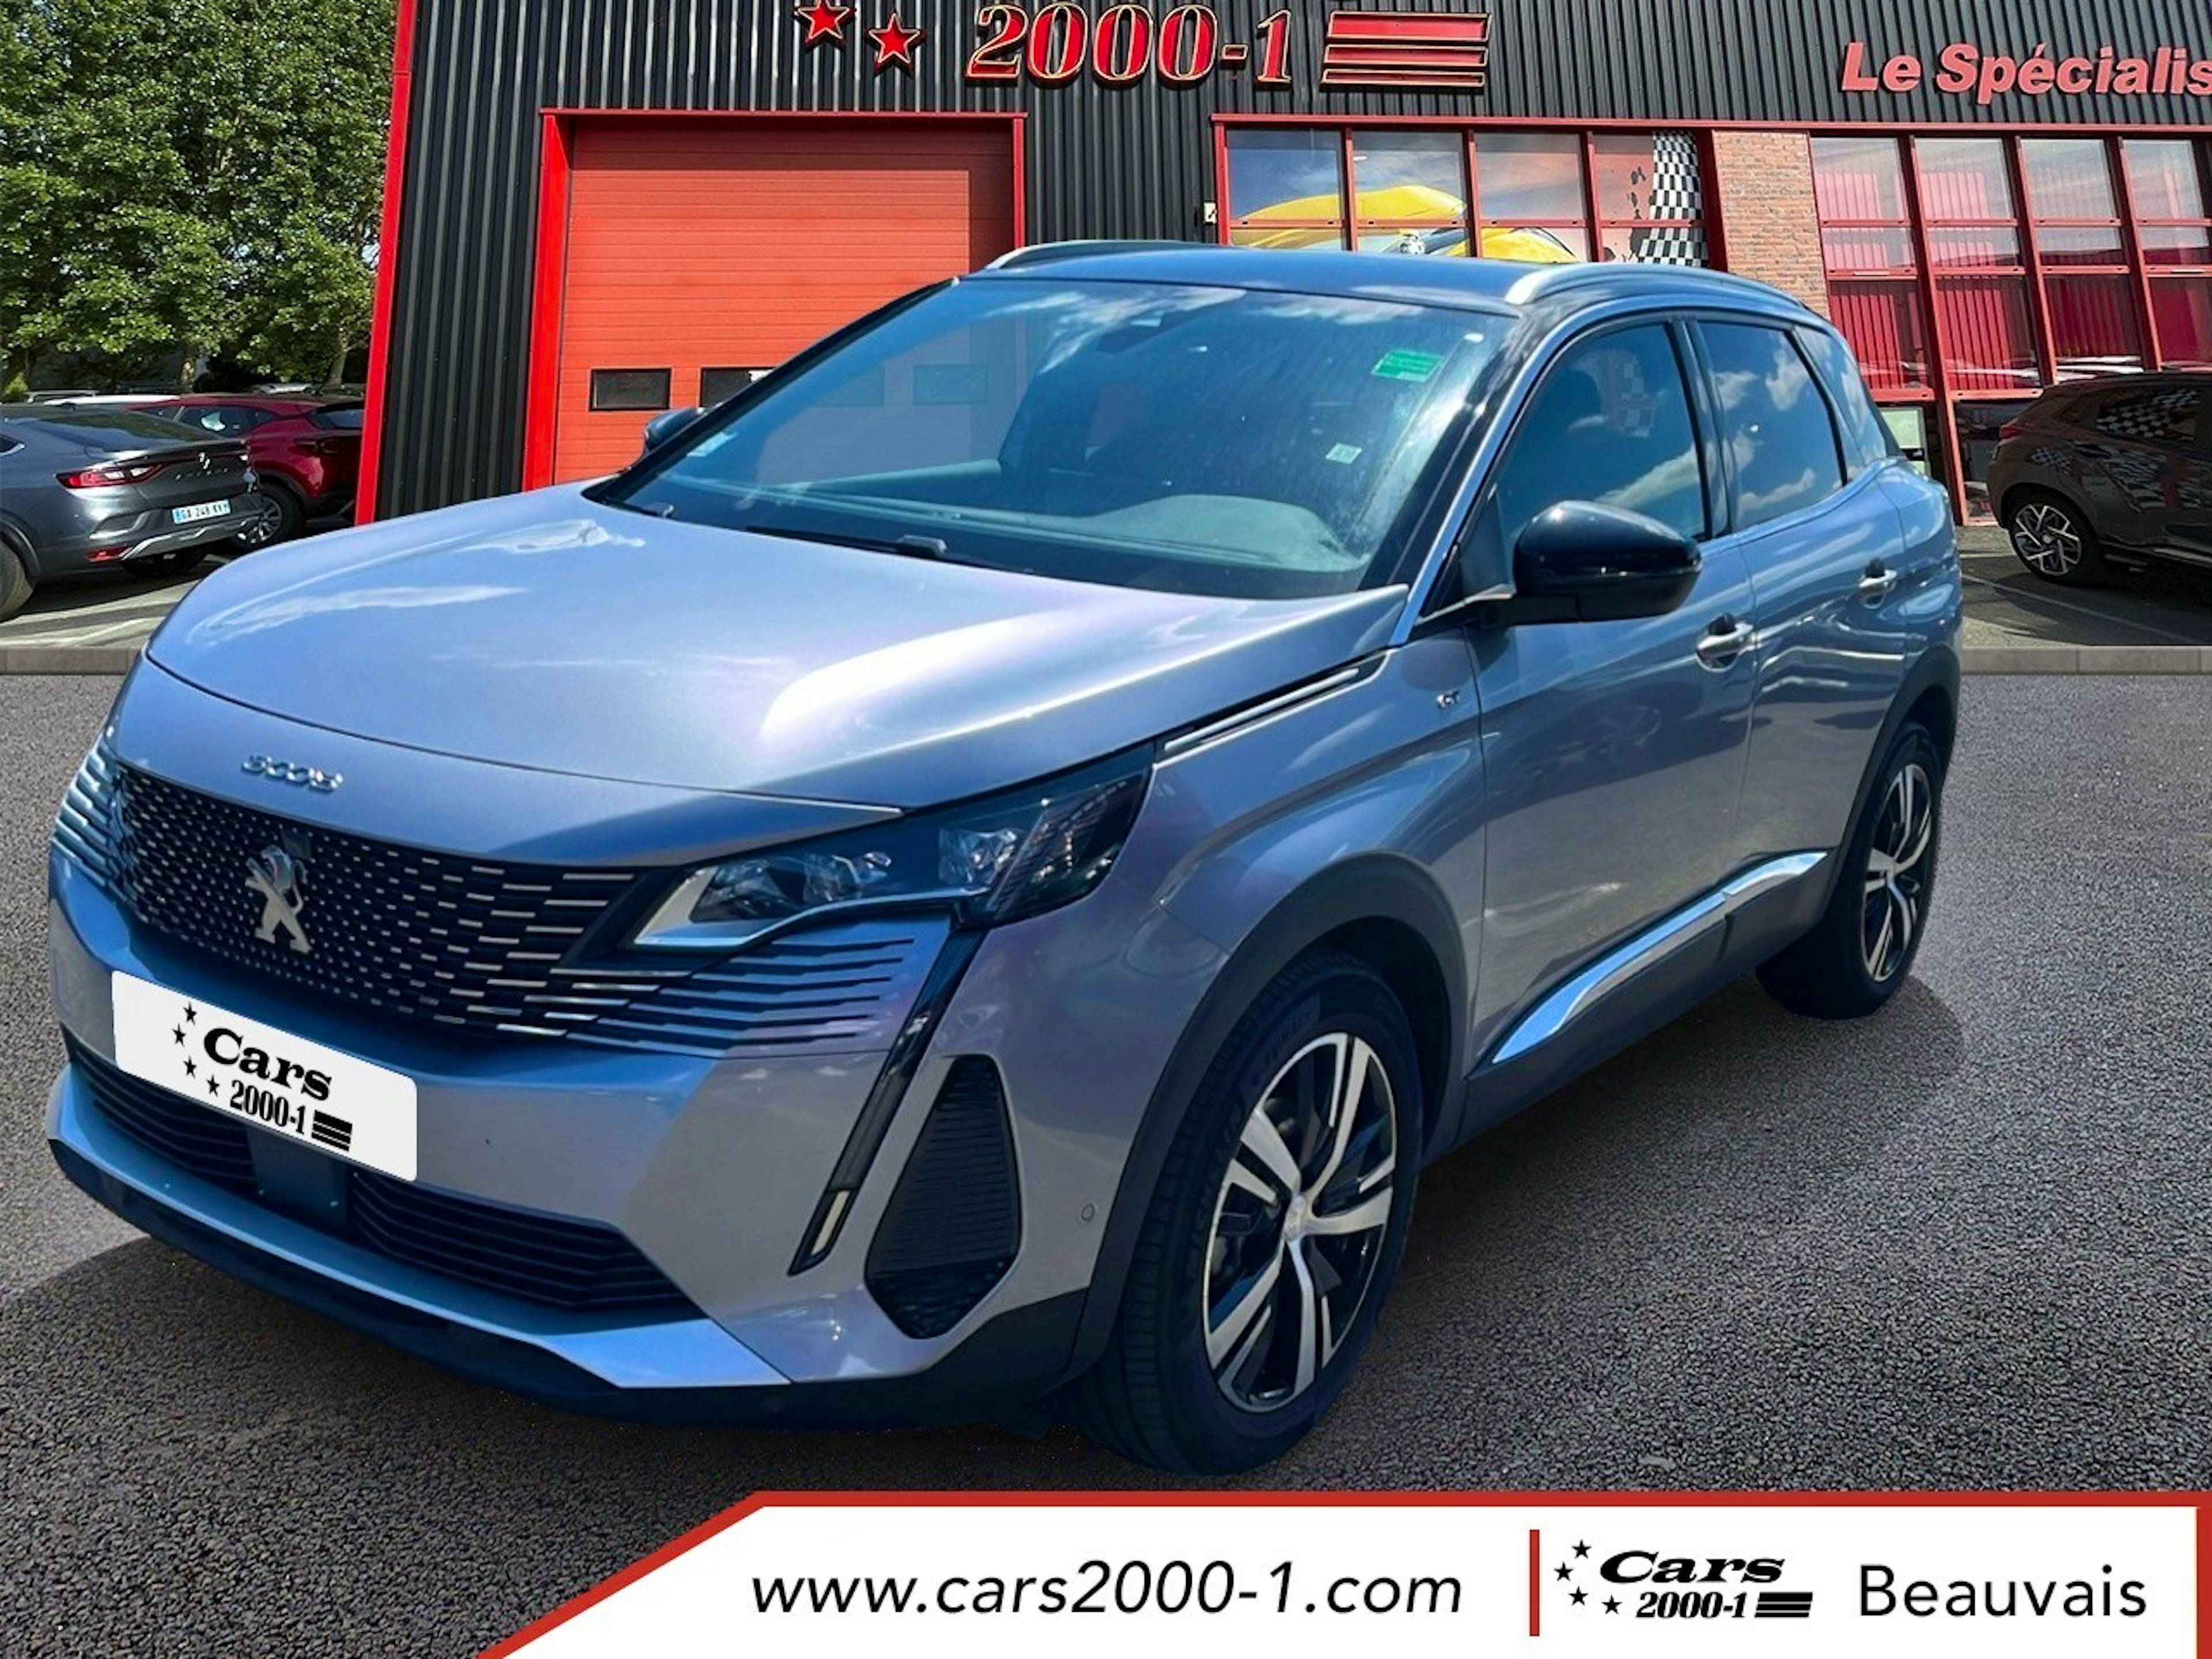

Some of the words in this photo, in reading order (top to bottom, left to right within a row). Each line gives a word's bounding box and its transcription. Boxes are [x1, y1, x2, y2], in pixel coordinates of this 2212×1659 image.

[965, 2, 1293, 82] 2000-1
[1841, 41, 1922, 92] Le
[1936, 41, 2212, 105] Spécialis
